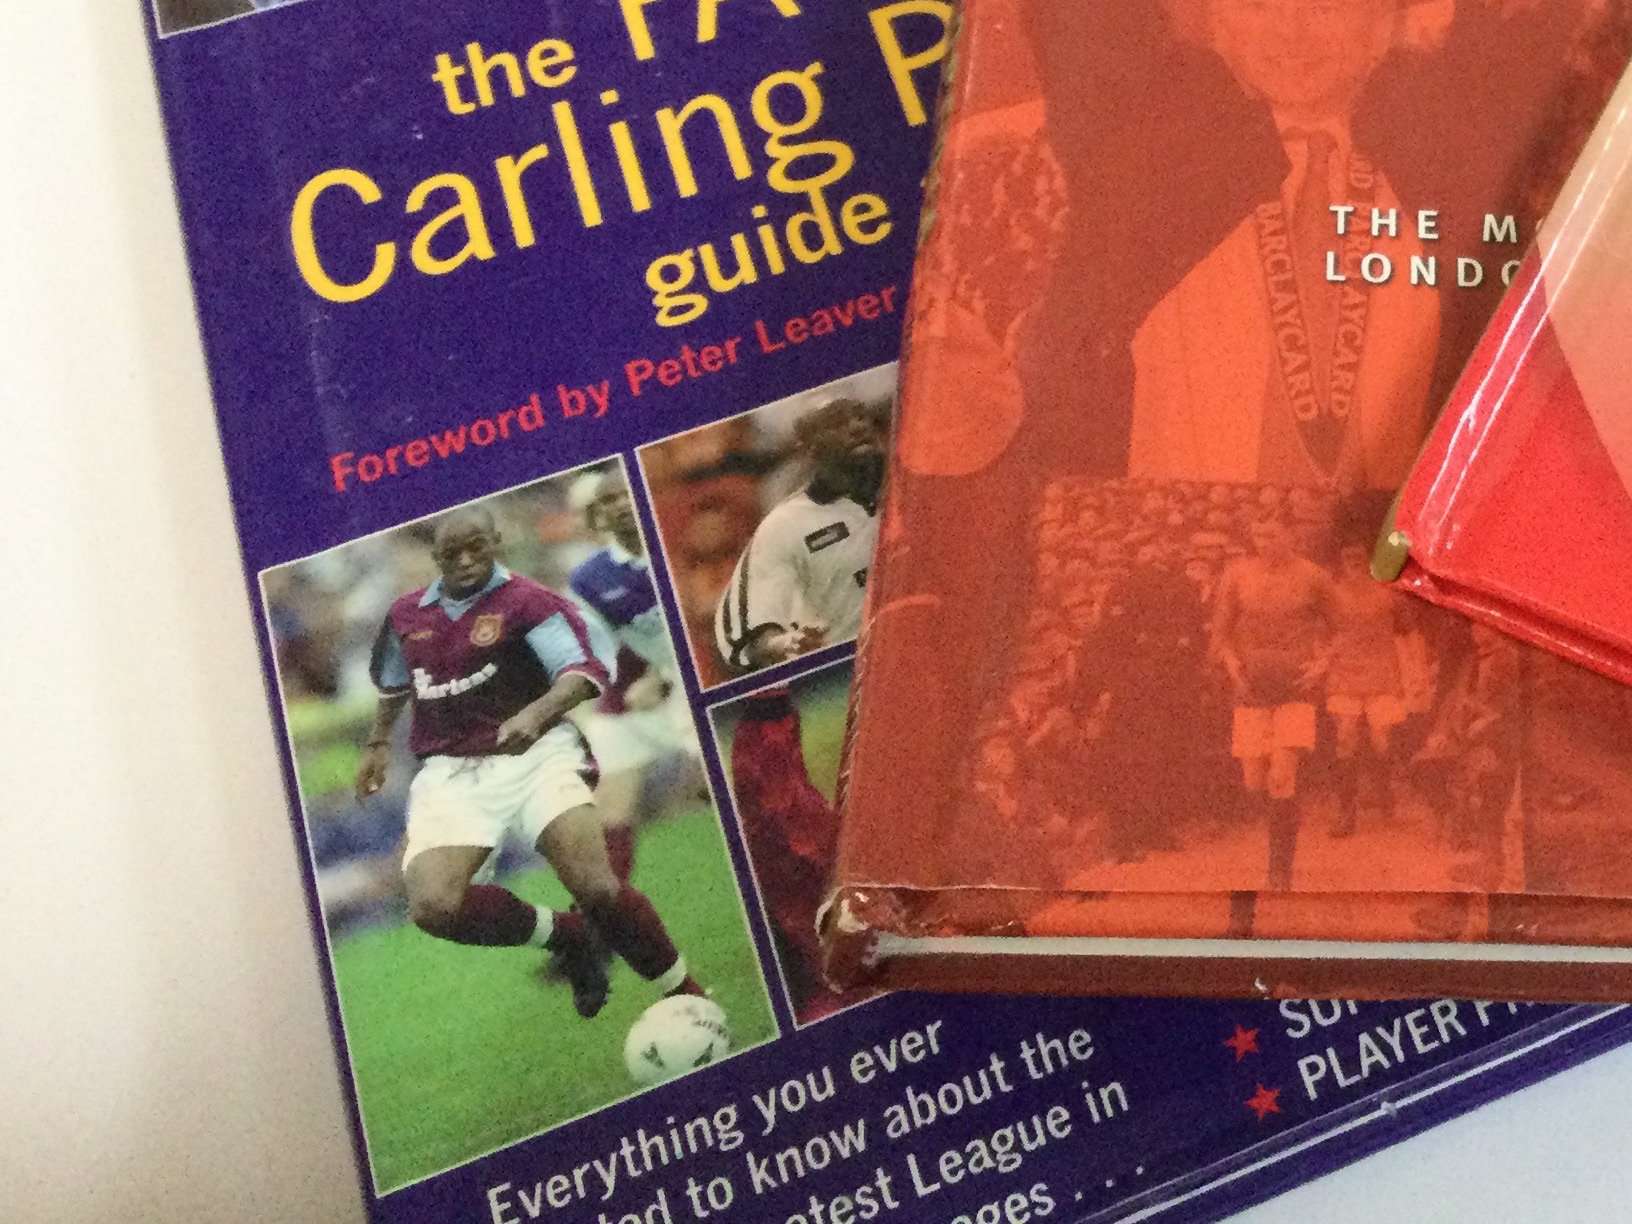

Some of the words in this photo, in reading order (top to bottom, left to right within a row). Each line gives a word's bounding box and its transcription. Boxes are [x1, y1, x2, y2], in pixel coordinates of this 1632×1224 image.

[431, 38, 578, 115] the
[290, 61, 856, 305] Carling
[645, 182, 894, 327] guide
[1328, 205, 1440, 240] THE
[329, 393, 545, 492] Foreword
[557, 379, 611, 419] by
[624, 335, 742, 398] Peter
[754, 285, 898, 355] Leaver
[1255, 200, 1321, 422] BARCLAYCARD
[486, 1103, 745, 1224] Everything
[752, 1066, 836, 1137] you
[850, 1020, 943, 1084] ever
[686, 1177, 734, 1218] to
[746, 1118, 867, 1194] know
[884, 1052, 1014, 1139] about
[1020, 1028, 1095, 1080] the
[1298, 999, 1467, 1101] PLAYER
[907, 1106, 1072, 1197] League
[1082, 1080, 1129, 1124] in
